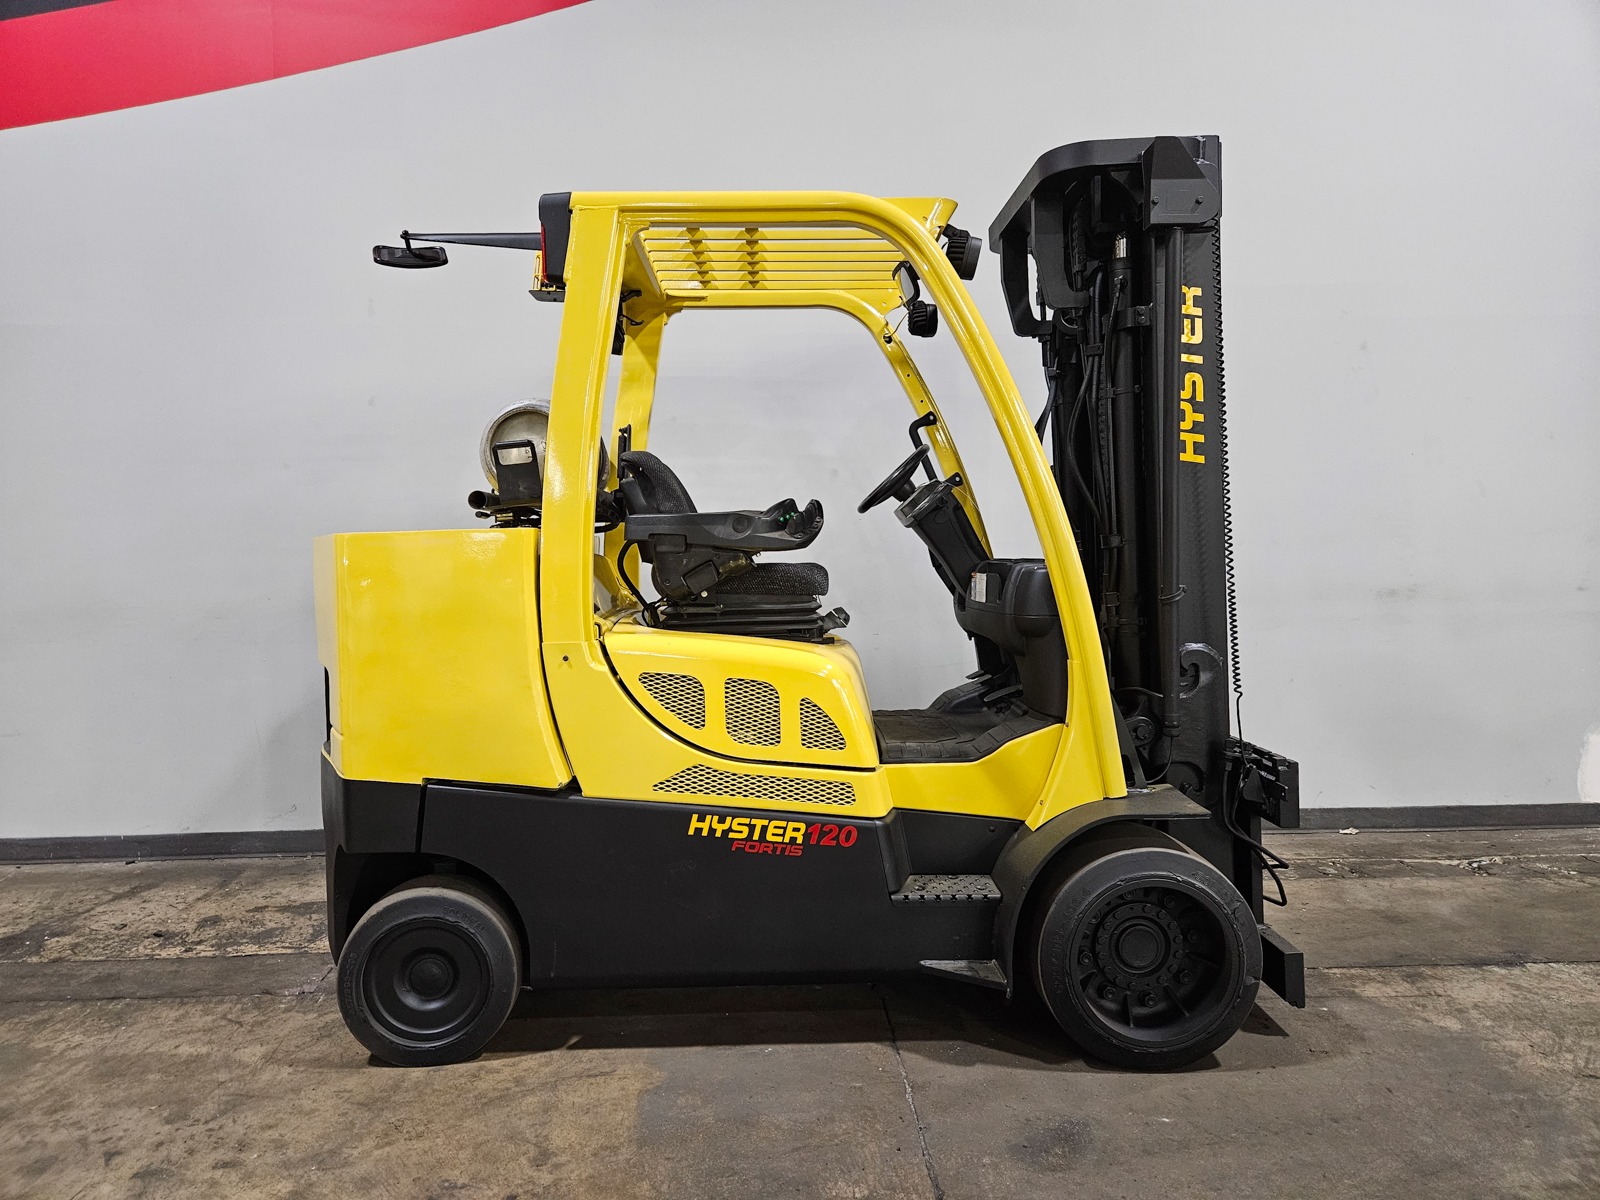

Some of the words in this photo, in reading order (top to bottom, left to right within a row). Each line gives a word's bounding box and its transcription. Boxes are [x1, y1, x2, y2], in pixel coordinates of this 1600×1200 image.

[687, 813, 806, 844] HYSTER
[807, 823, 858, 847] 120
[731, 840, 804, 856] FORTIS
